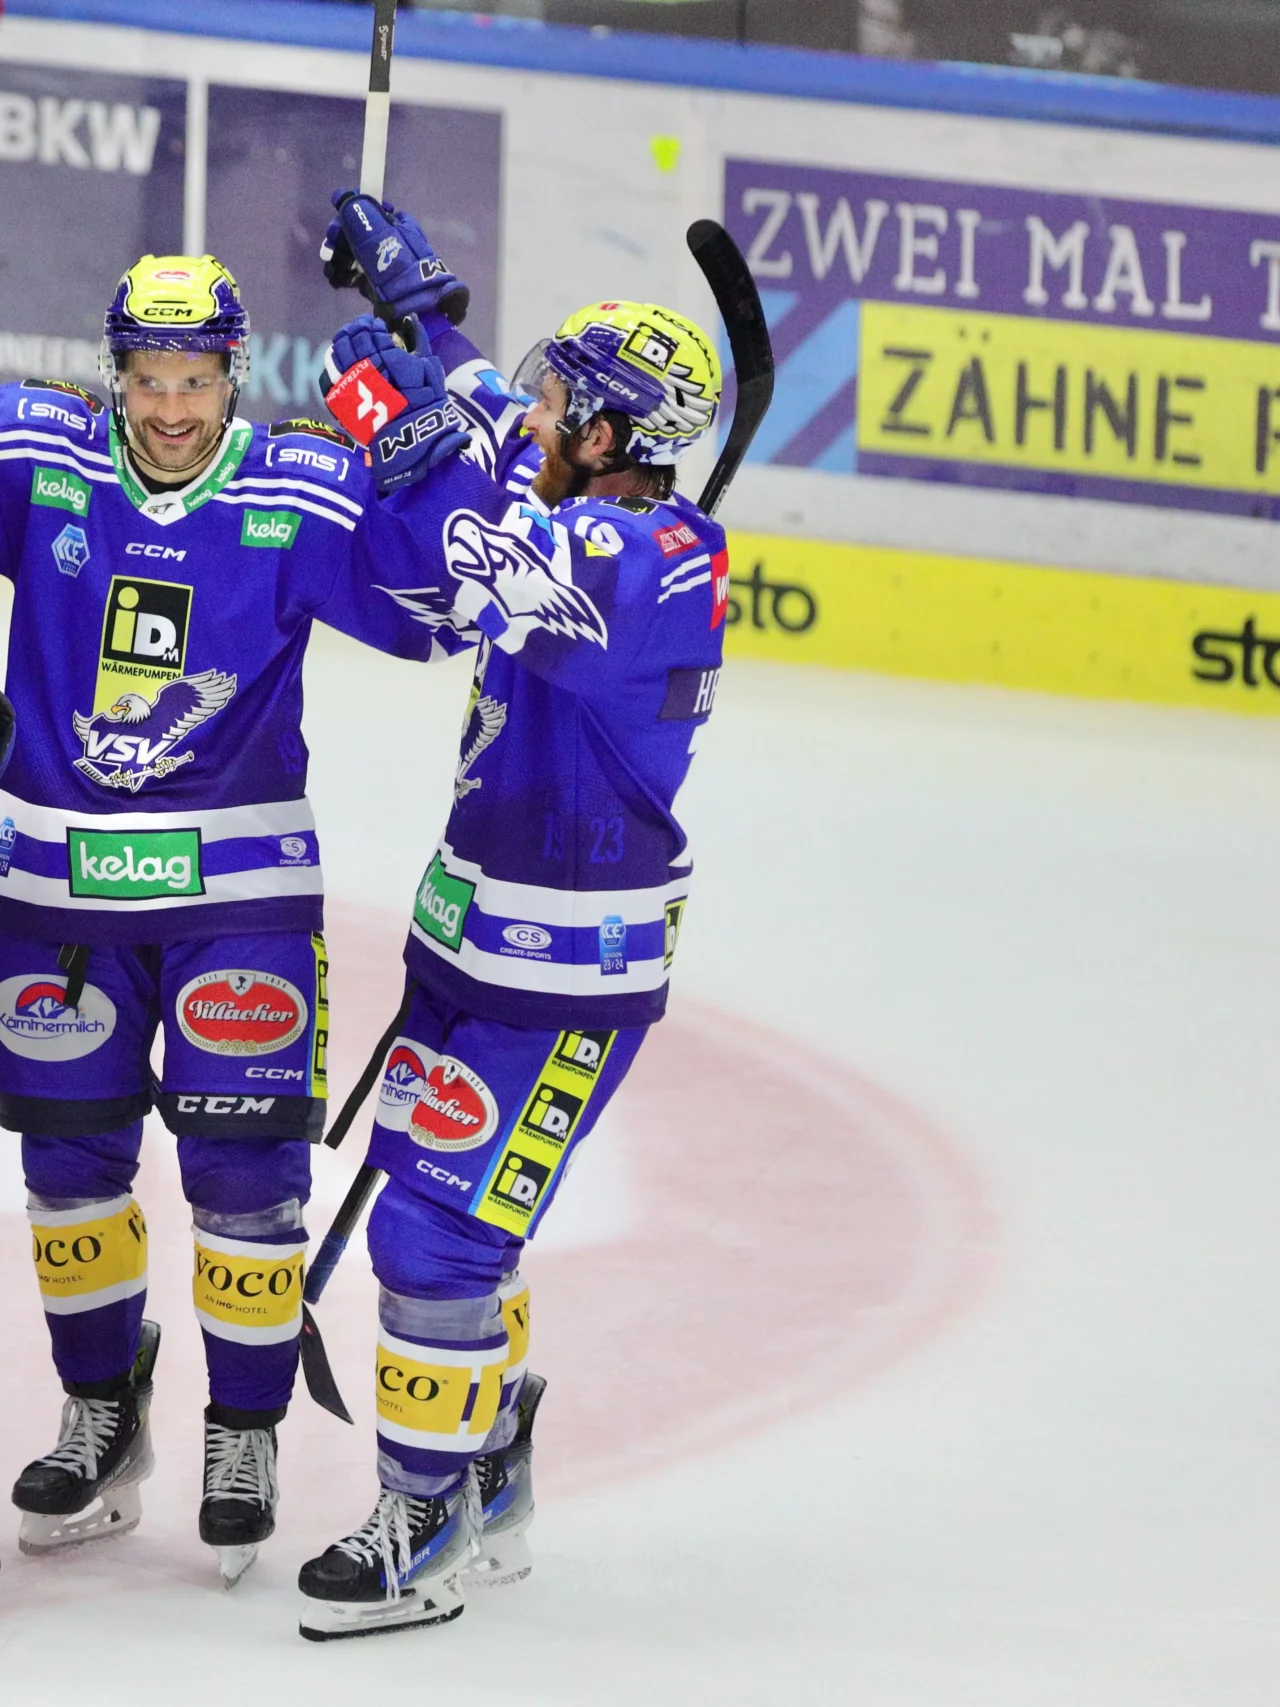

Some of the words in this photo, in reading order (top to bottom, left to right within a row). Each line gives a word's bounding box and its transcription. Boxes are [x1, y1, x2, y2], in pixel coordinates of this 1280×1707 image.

[353, 203, 373, 232] CCM
[740, 187, 982, 298] ZWEI
[1024, 214, 1213, 322] MAL
[144, 307, 193, 319] CCM
[595, 371, 639, 401] CCM
[879, 328, 1206, 468] ZÄHNE
[35, 471, 88, 514] kelag
[125, 542, 187, 562] CCM
[101, 661, 181, 681] WÄRMEPUMPEN
[87, 730, 172, 765] VSV
[81, 842, 191, 889] kelag
[516, 929, 542, 943] CS
[601, 923, 624, 938] ICE
[499, 947, 552, 961] CREATE-SPORTS
[198, 974, 218, 985] SEIT
[188, 1000, 294, 1022] Villacher
[245, 1067, 304, 1081] CCM
[551, 1059, 596, 1082] WÄRMEPUMPEN
[177, 1095, 276, 1114] CCM
[518, 1126, 563, 1150] WÄRMEPUMPEN
[416, 1158, 473, 1192] CCM
[487, 1195, 530, 1219] WÄRMEPUMPEN
[53, 1275, 84, 1285] HOTEL
[216, 1300, 233, 1310] IHG
[236, 1306, 269, 1315] HOTEL
